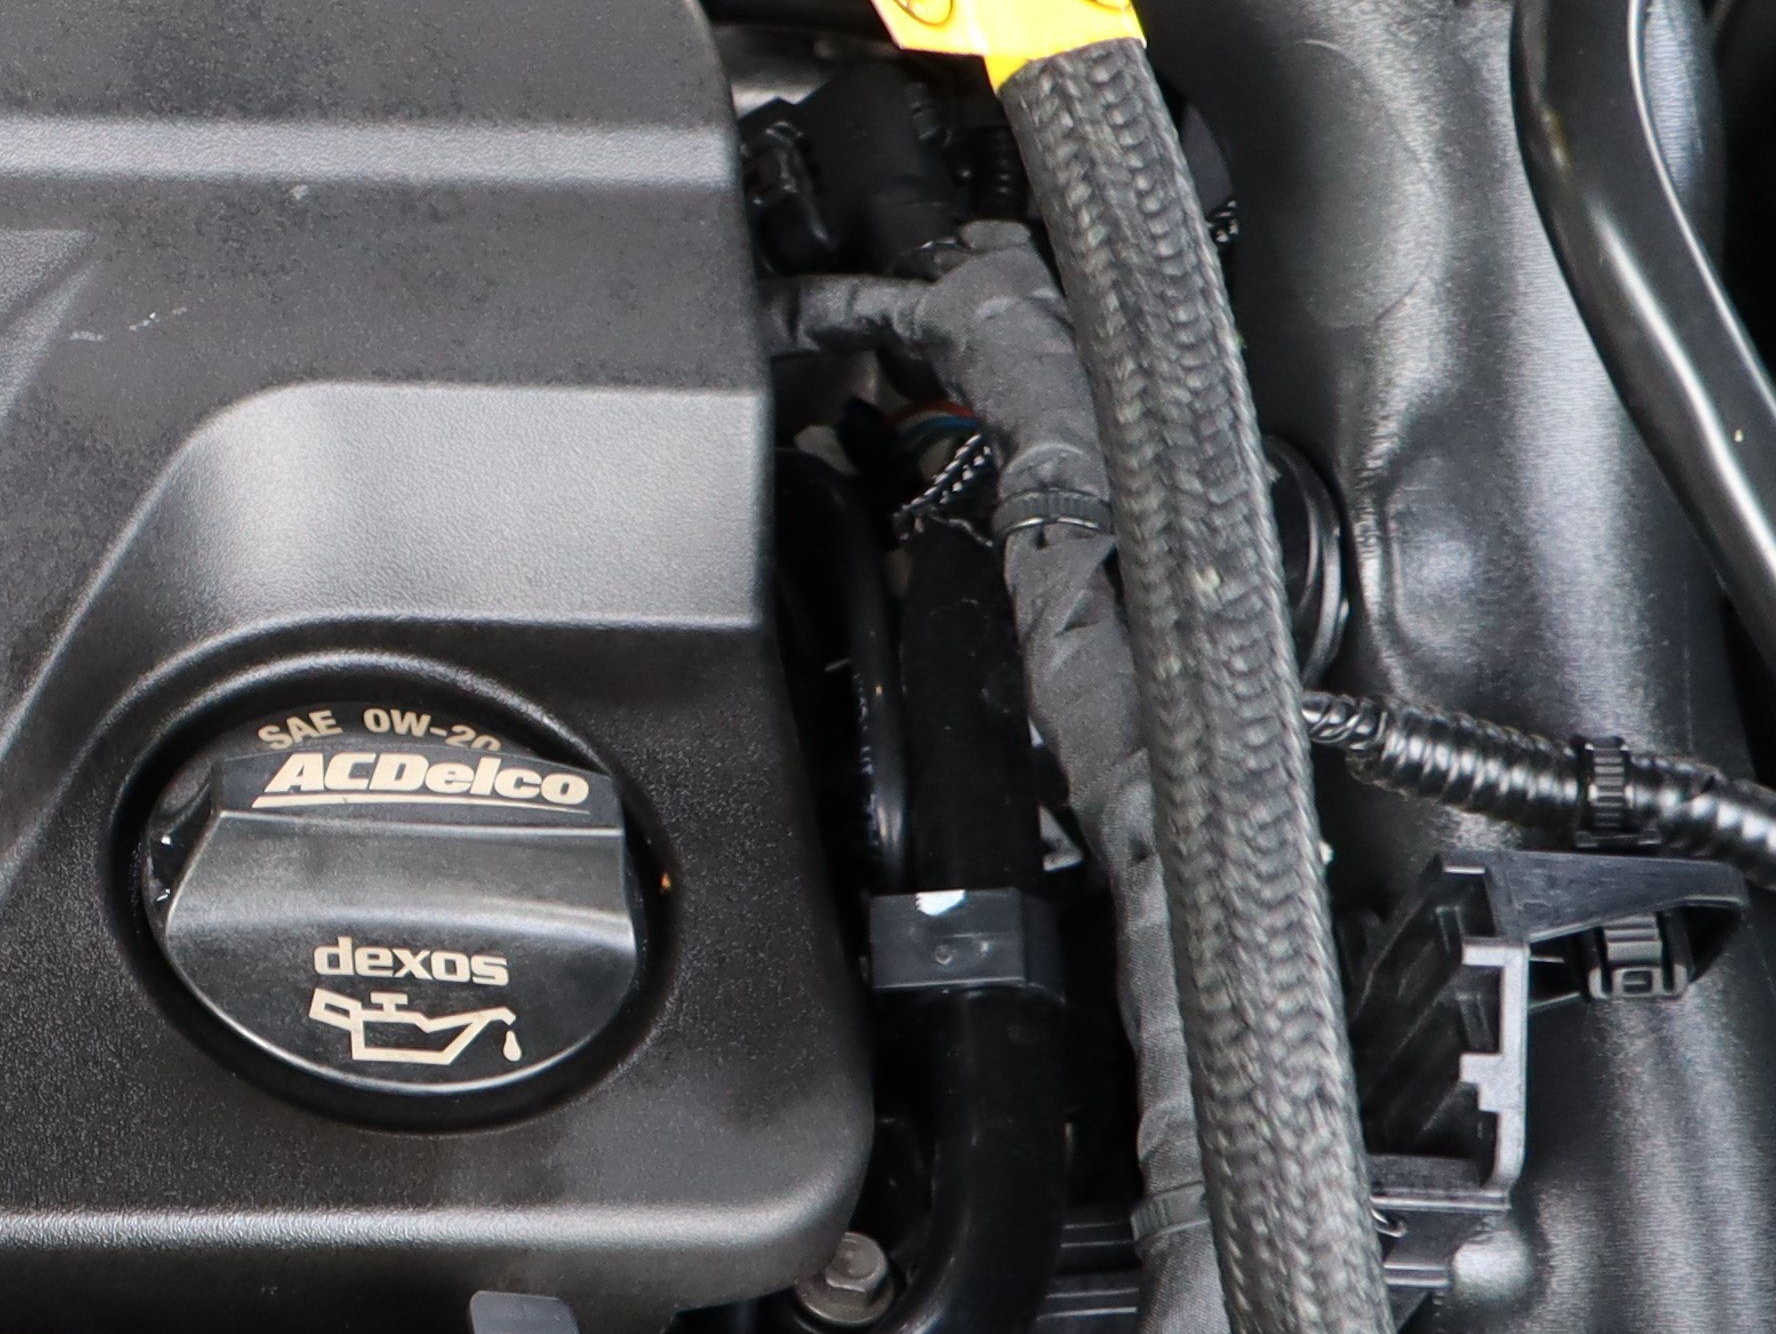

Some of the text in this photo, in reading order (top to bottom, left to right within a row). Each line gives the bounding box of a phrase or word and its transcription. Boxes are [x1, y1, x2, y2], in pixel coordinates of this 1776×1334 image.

[257, 707, 502, 751] SAE 0W-20
[263, 751, 591, 806] ACDelco
[313, 936, 510, 987] dexos
